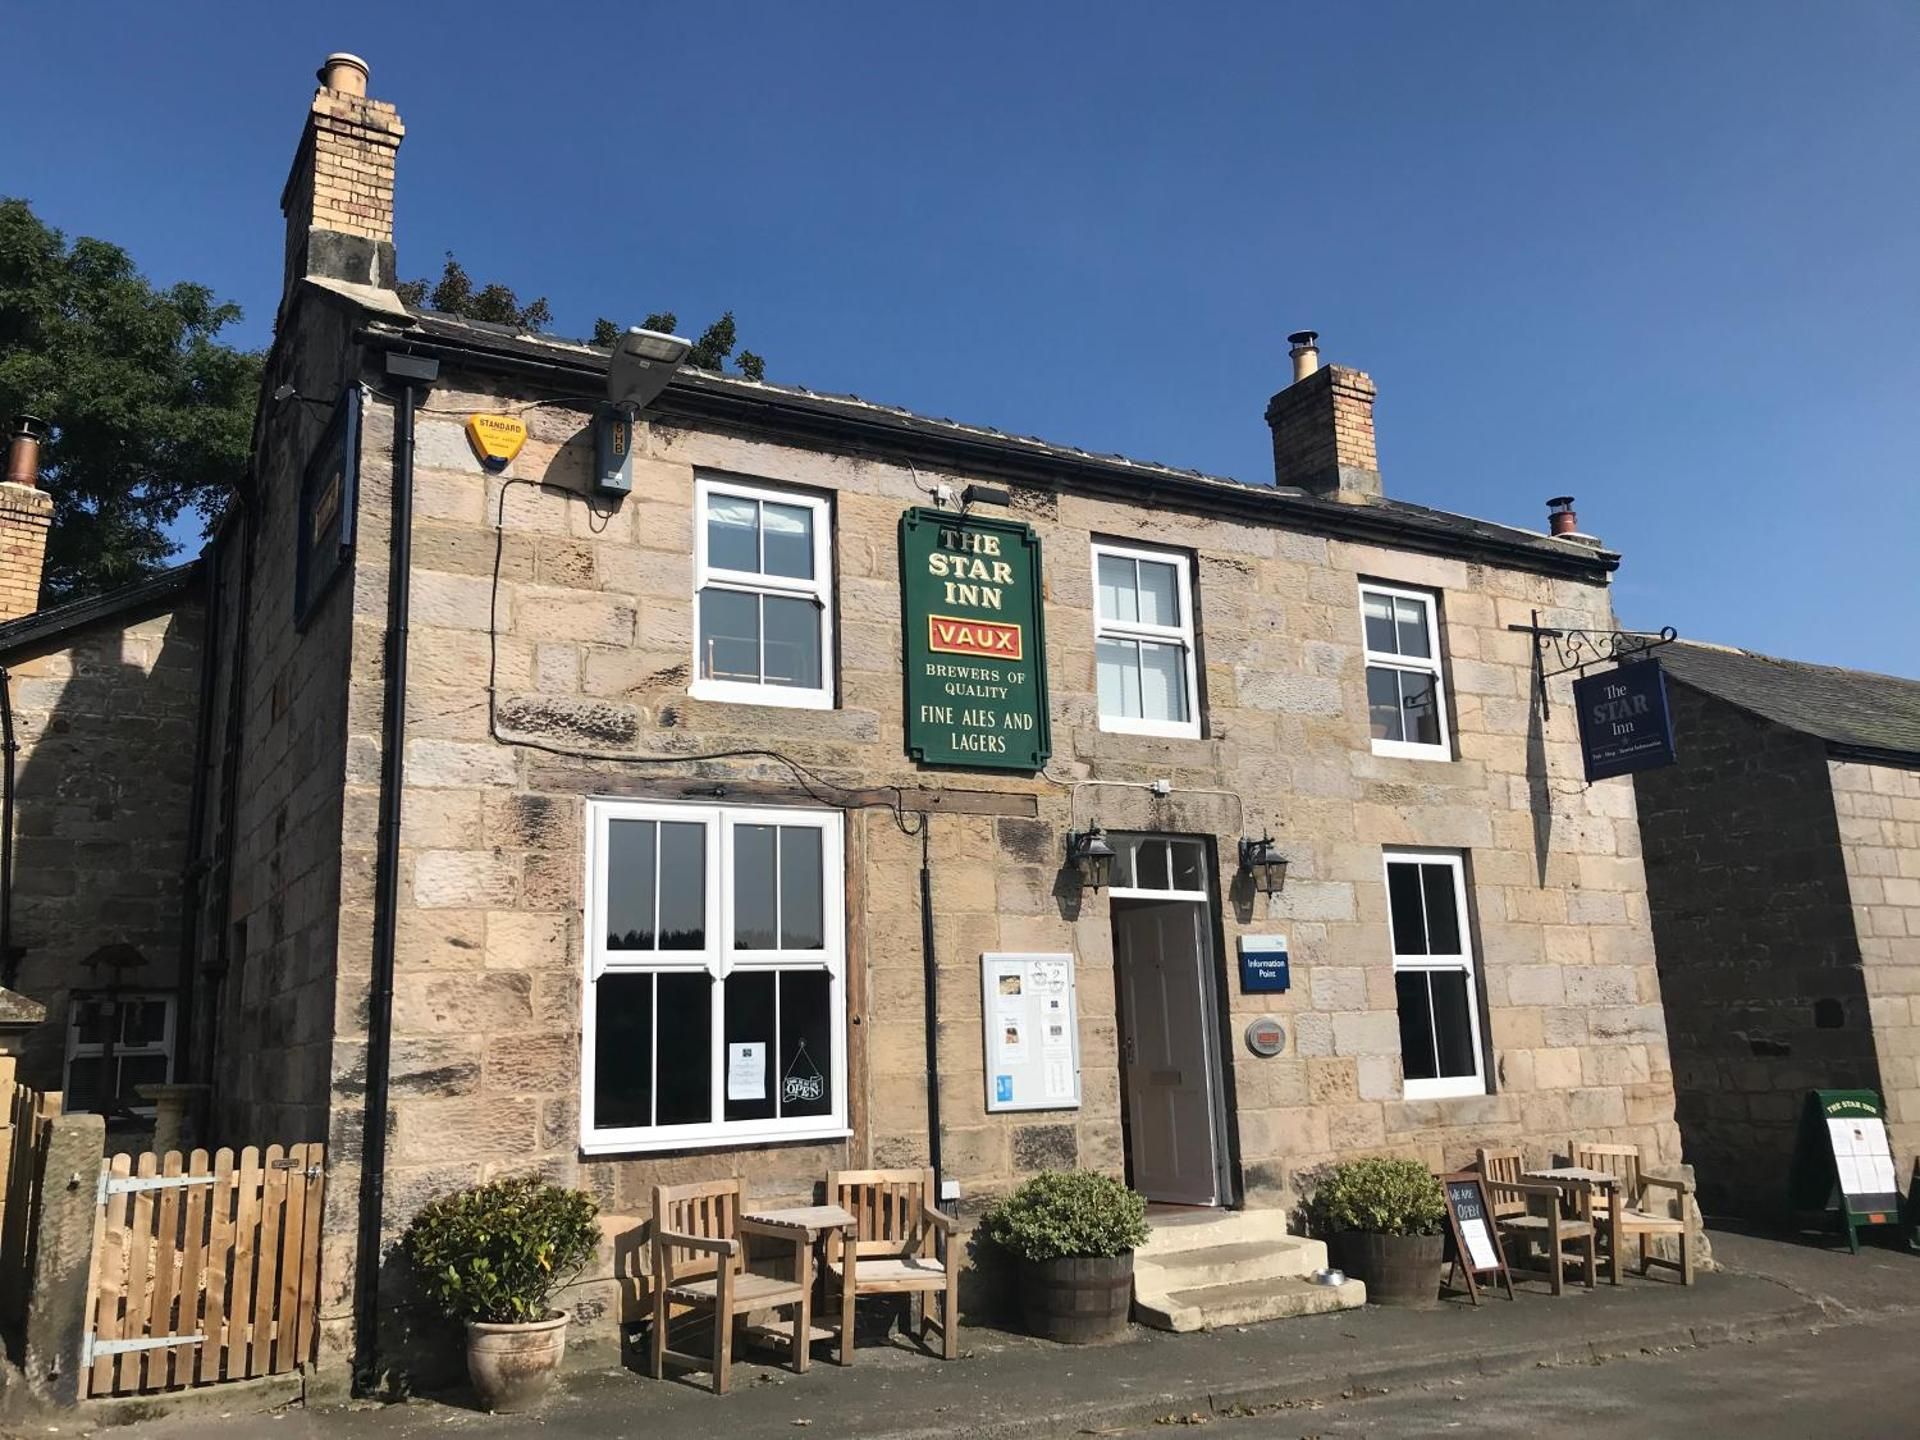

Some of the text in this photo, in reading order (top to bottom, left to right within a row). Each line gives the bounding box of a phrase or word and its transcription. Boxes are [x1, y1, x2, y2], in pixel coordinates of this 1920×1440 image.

[480, 418, 522, 433] STANDARD
[940, 528, 1000, 555] THE
[928, 553, 1014, 584] STAR
[944, 582, 1002, 610] INN
[937, 623, 1014, 651] VAUX
[926, 664, 1025, 684] BREWERS OF
[945, 683, 1008, 700] QUALITY
[1603, 684, 1627, 700] The
[1592, 693, 1649, 725] STAR
[921, 705, 1033, 731] FINE ALES AND
[1611, 721, 1635, 736] Inn
[951, 732, 1006, 753] LAGERS
[1247, 958, 1285, 968] Information
[1259, 969, 1277, 978] Point
[786, 1083, 820, 1097] OPEN
[1826, 1102, 1842, 1114] THE
[1841, 1100, 1861, 1108] STAR
[1457, 1204, 1480, 1219] OPEN
